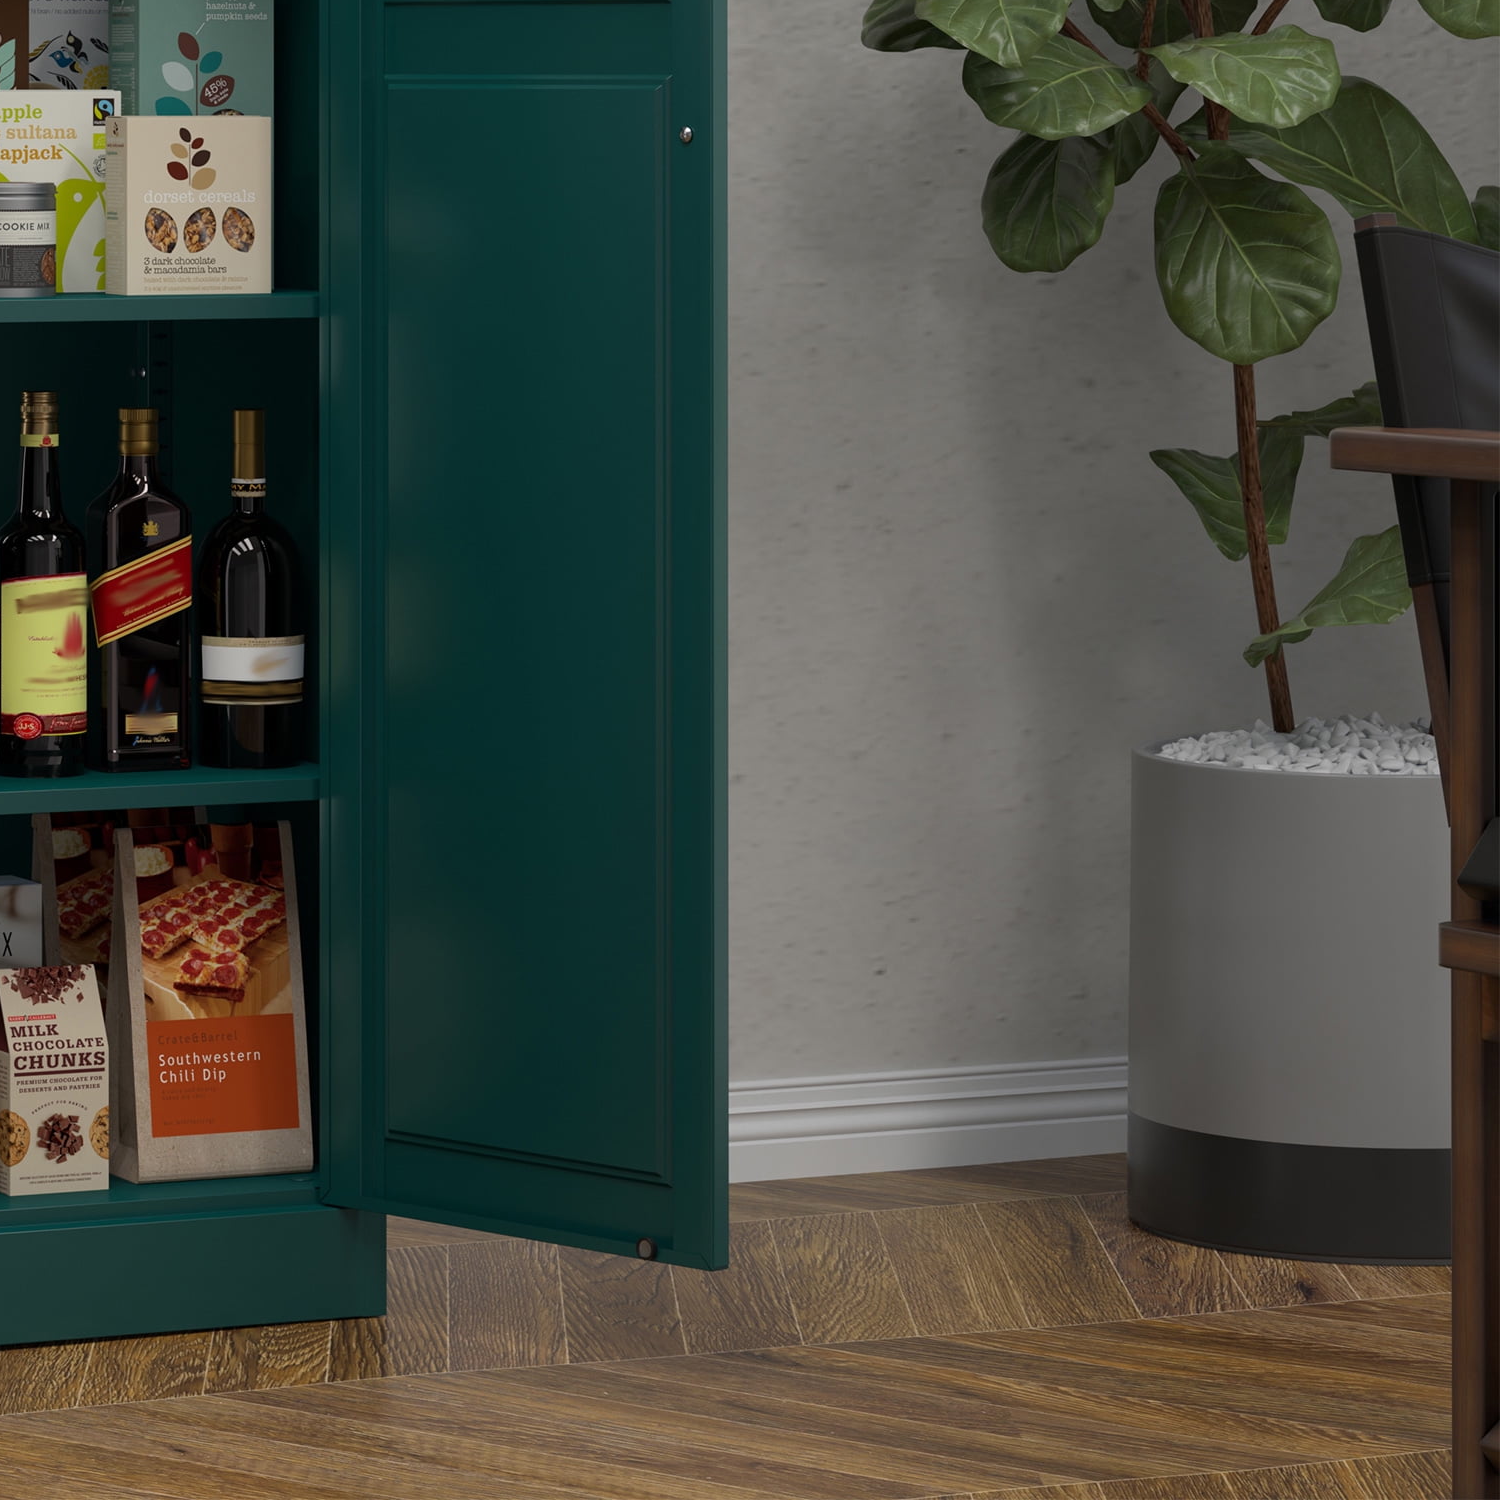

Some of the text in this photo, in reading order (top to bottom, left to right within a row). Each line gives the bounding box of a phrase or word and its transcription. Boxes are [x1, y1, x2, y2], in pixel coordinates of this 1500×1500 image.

[205, 1, 257, 10] hazelnuts &
[205, 11, 268, 22] pumpkin seeds
[6, 125, 77, 140] sultana
[144, 189, 256, 204] dorset cereals
[36, 222, 50, 230] MIX
[144, 257, 216, 266] 3 dark chocolate
[144, 265, 228, 275] & macadamia bars
[9, 1024, 59, 1039] MILK
[158, 1029, 238, 1045] Crate&Barrel
[12, 1037, 105, 1052] CHOCOLATE
[13, 1051, 106, 1071] CHUNKS
[158, 1049, 261, 1067] Southwestern
[16, 1078, 48, 1086] PREMIUM
[49, 1076, 89, 1084] CHOCOLATE
[159, 1067, 228, 1084] Chili Dip
[18, 1083, 101, 1094] DESSERTS AND PASTRIES
